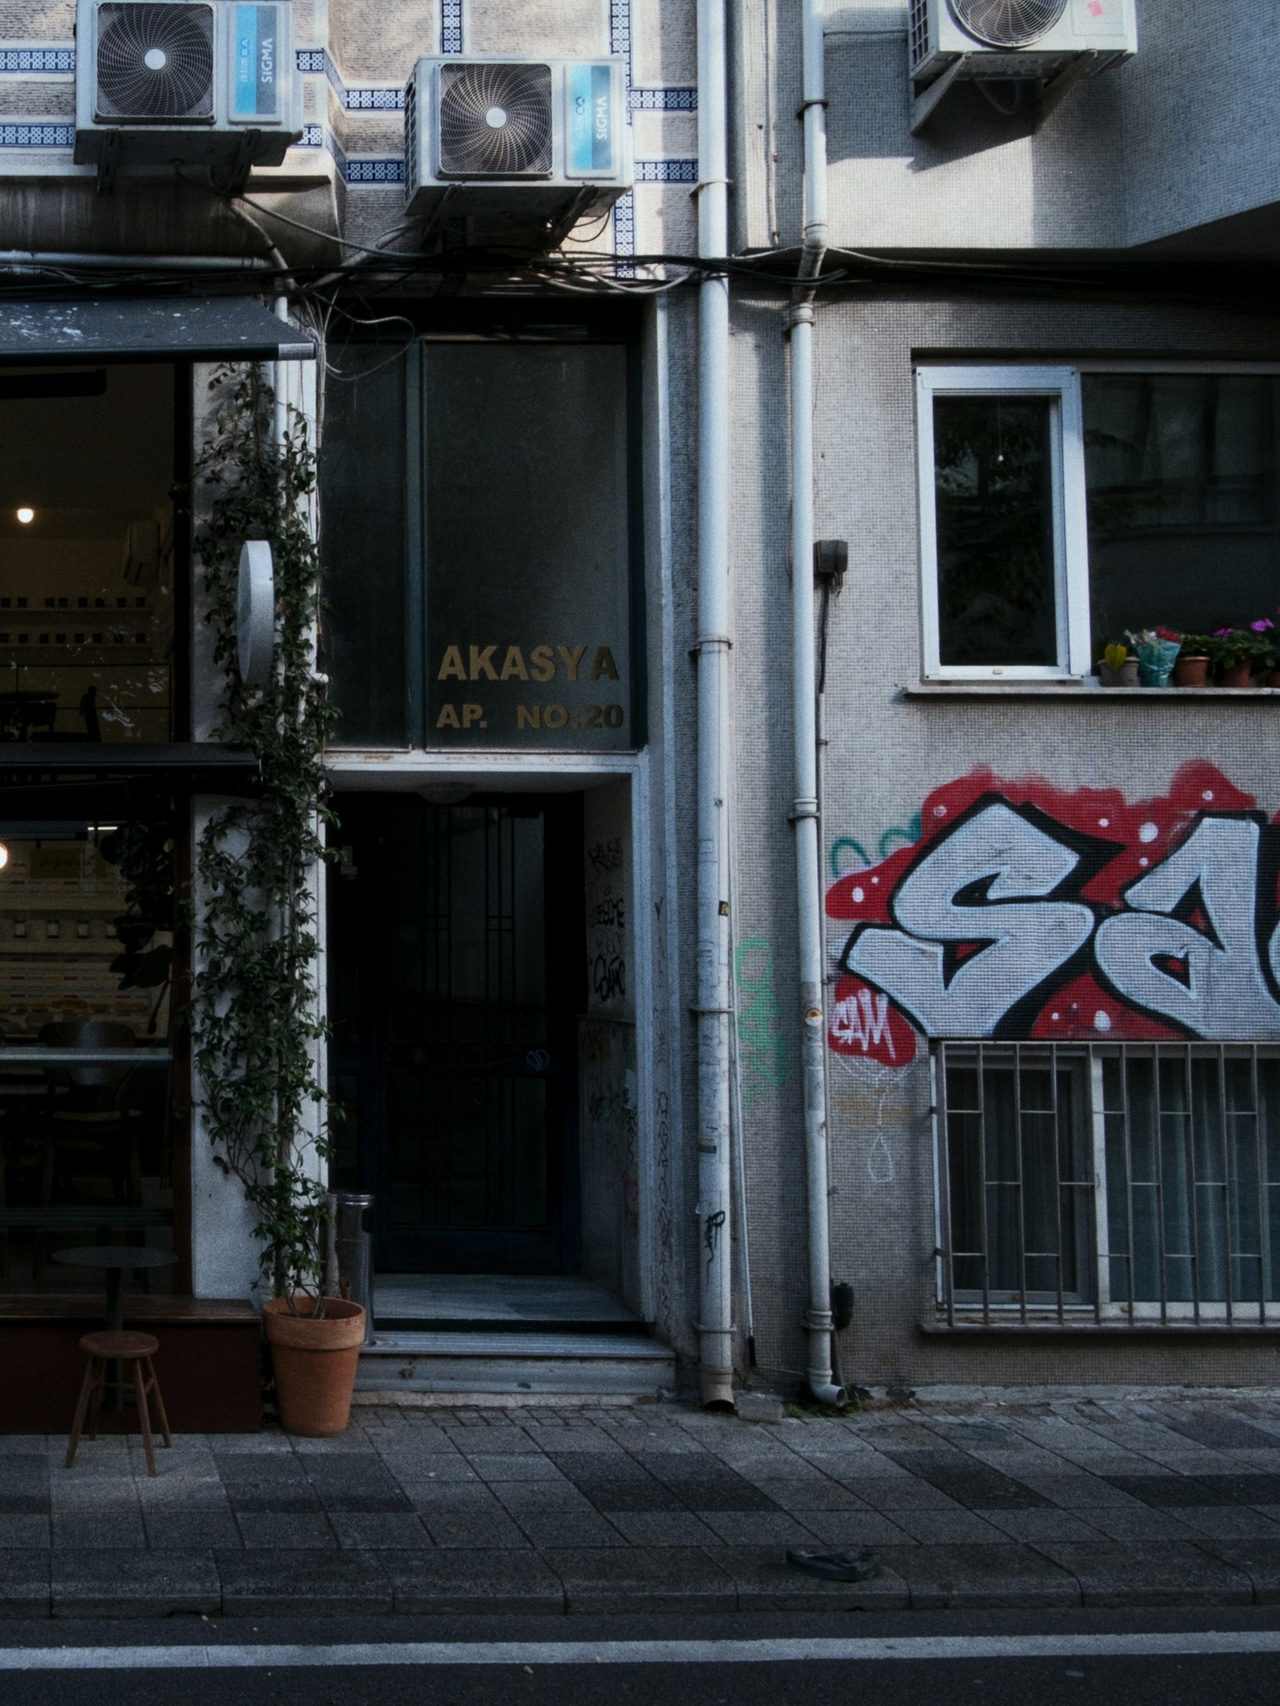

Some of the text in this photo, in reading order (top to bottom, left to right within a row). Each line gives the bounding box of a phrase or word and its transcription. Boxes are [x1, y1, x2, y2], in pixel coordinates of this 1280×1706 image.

[261, 37, 273, 83] SIGMA
[596, 96, 607, 140] SIGMA
[437, 645, 620, 682] AKASYA
[435, 703, 624, 729] AP. NO:20
